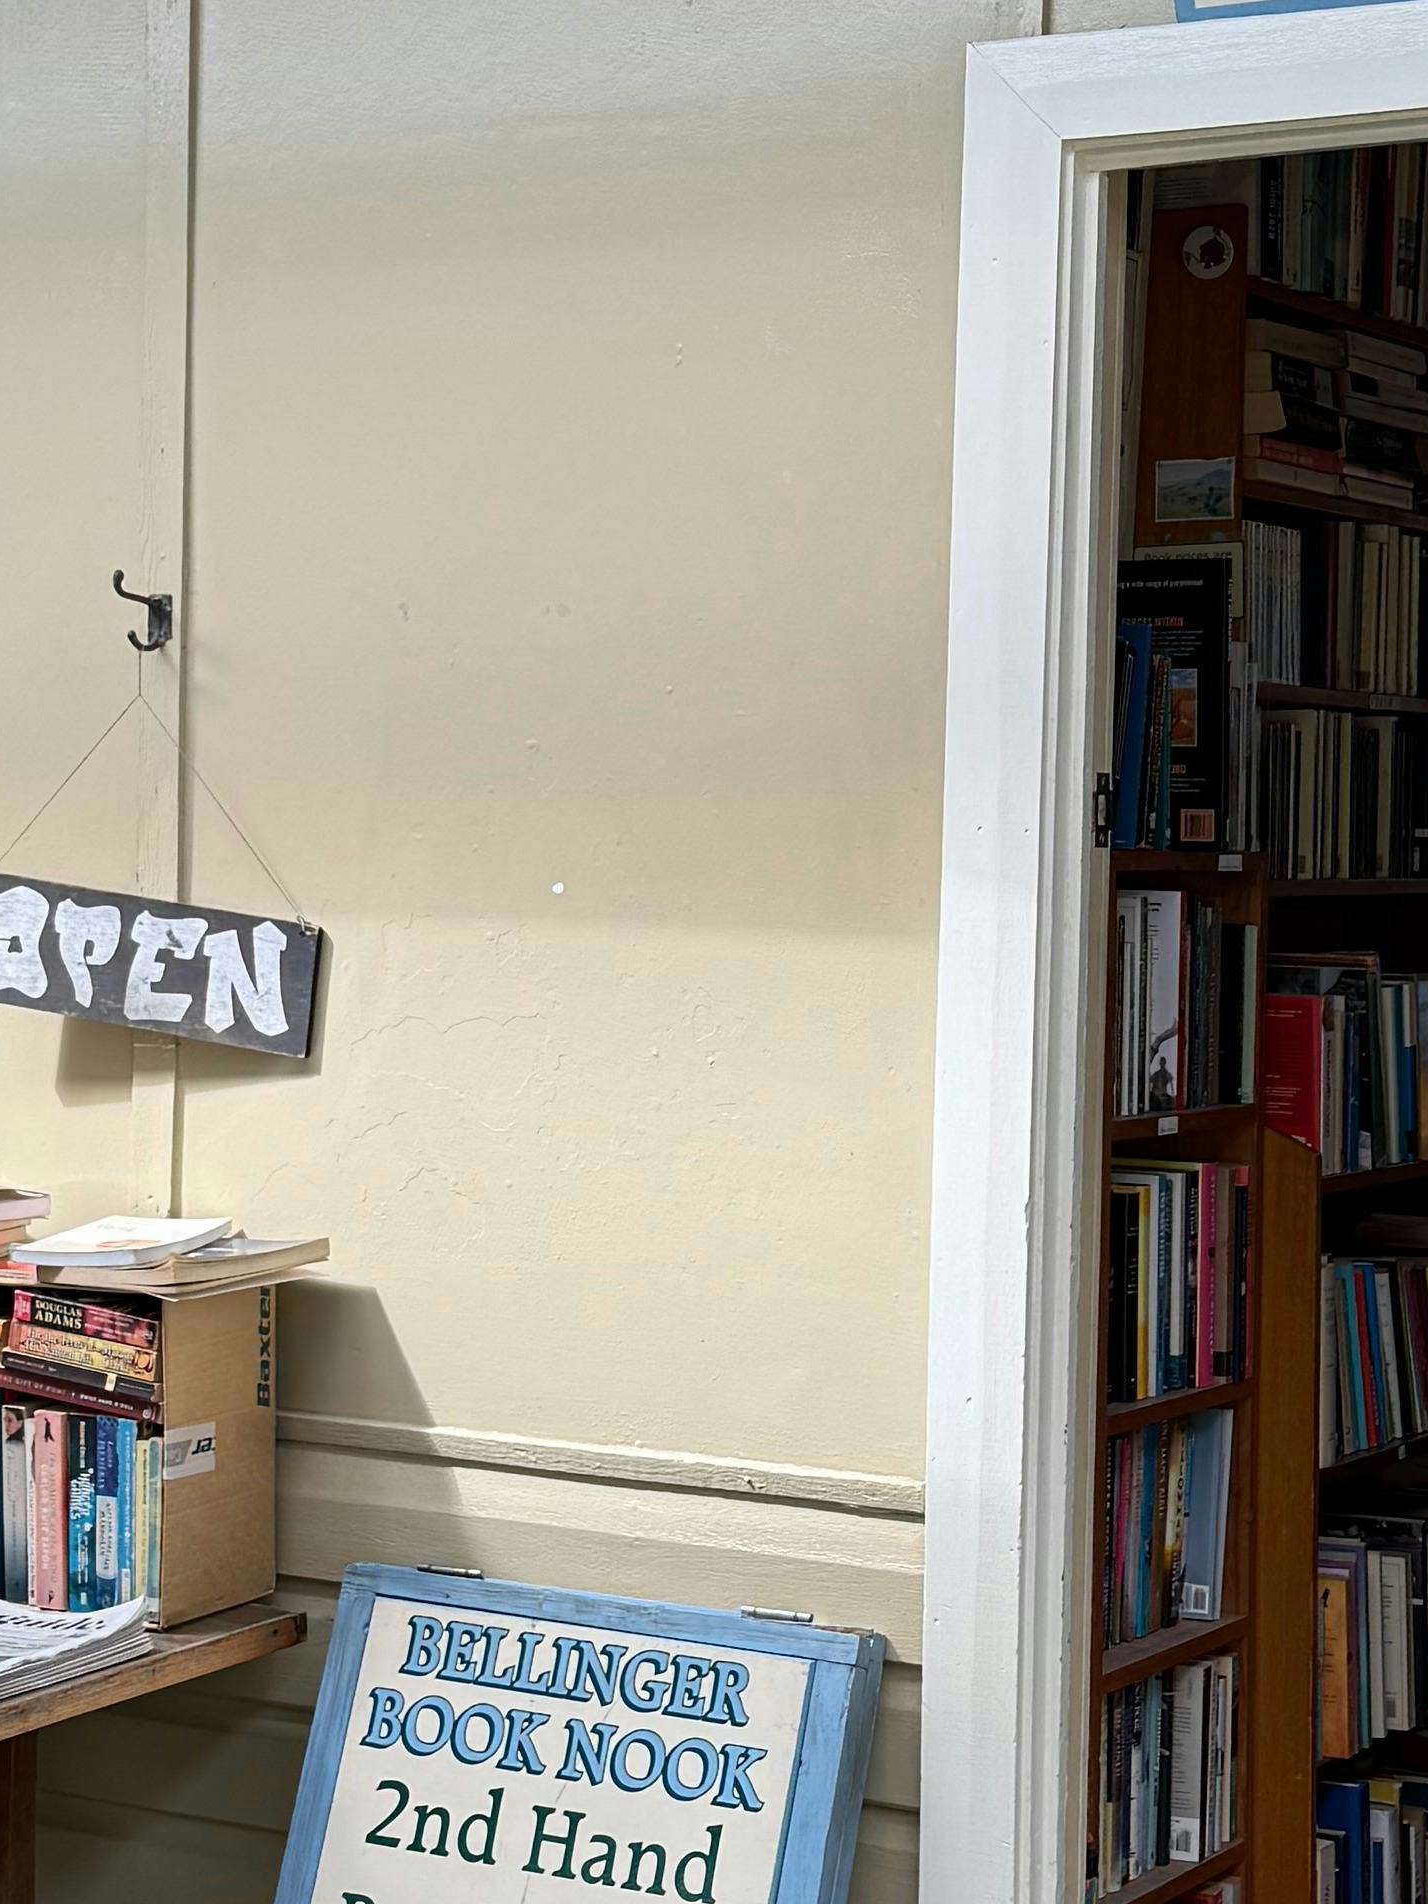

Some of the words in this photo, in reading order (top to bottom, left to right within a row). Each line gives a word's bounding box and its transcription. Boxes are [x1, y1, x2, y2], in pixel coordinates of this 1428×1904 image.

[34, 1312, 82, 1330] ADAMS
[35, 1299, 83, 1317] DOUGLAS
[400, 1615, 751, 1727] BELLINGER
[361, 1690, 553, 1776] BOOK
[561, 1716, 768, 1814] NOOK
[365, 1778, 505, 1867] 2nd
[528, 1803, 724, 1904] Hand
